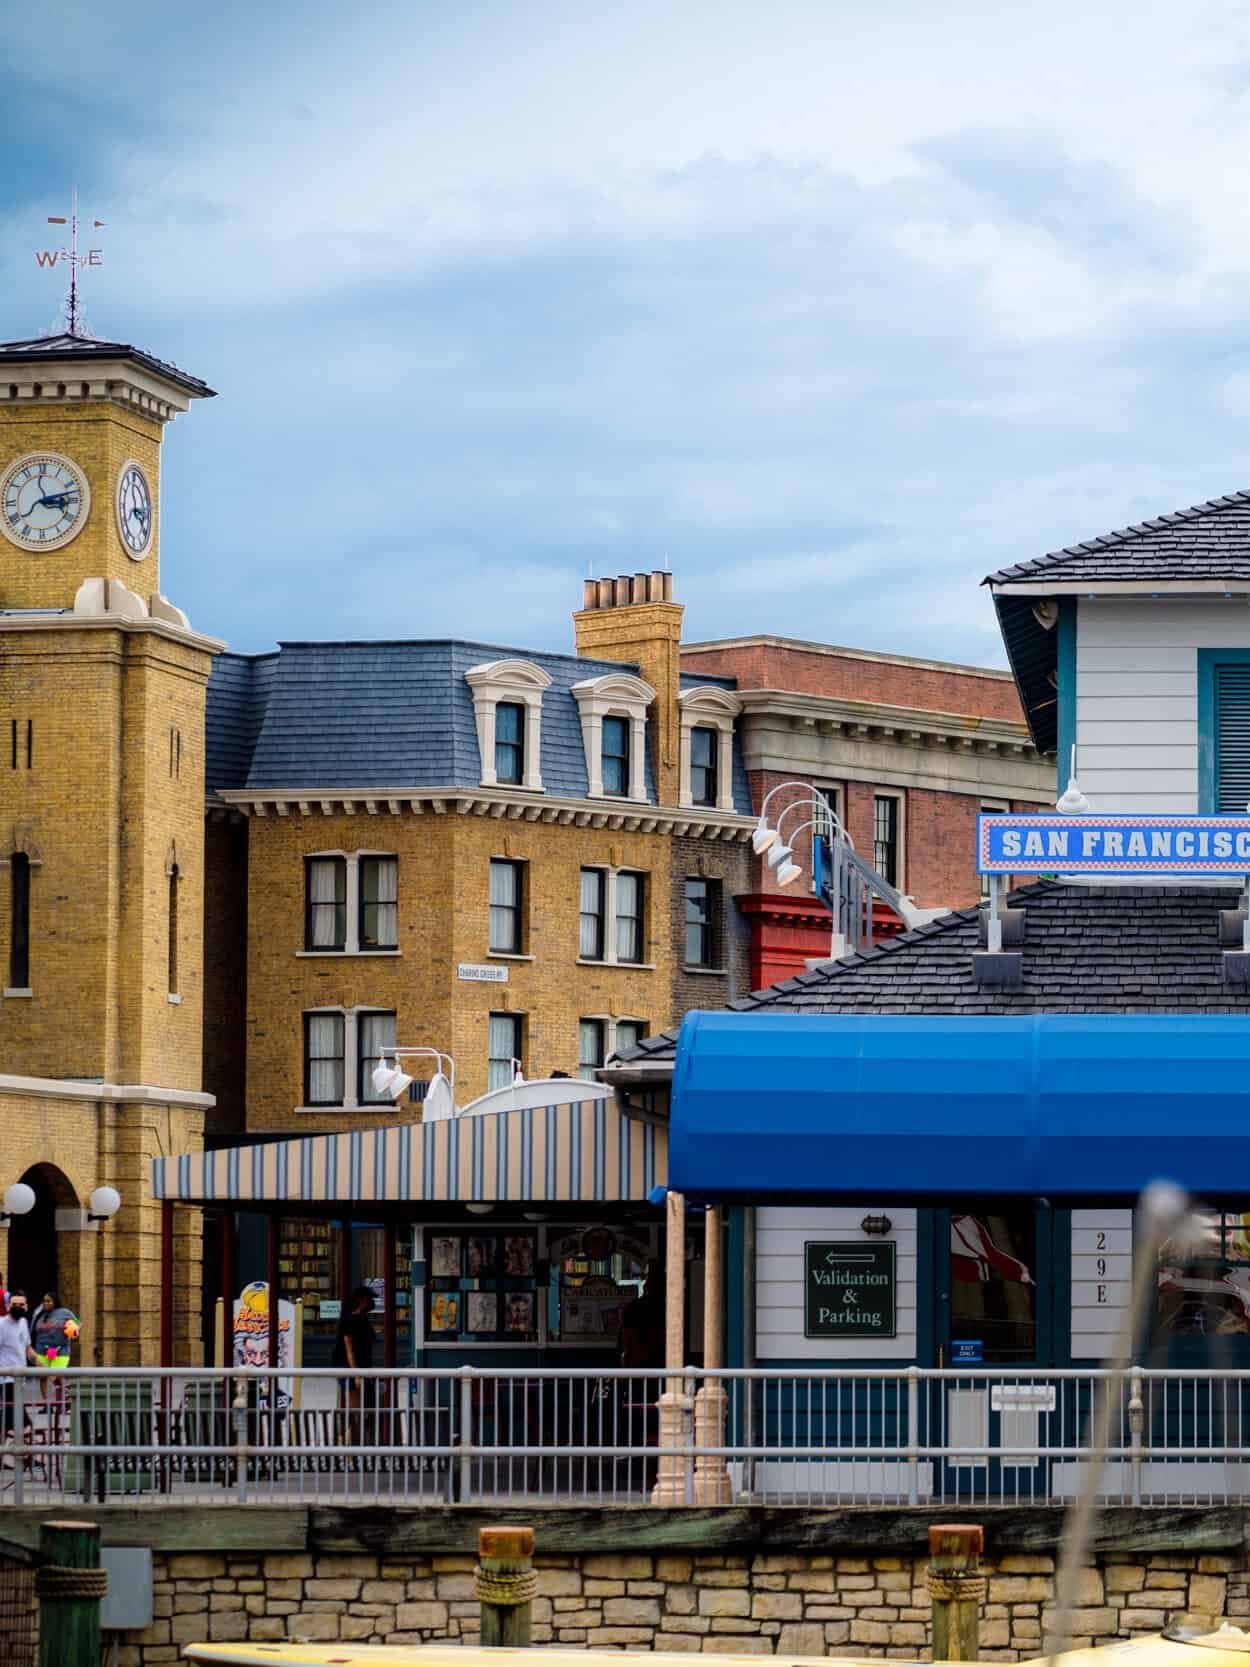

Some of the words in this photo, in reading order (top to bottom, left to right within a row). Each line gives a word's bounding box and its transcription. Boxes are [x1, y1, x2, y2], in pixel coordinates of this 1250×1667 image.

[36, 251, 58, 267] W
[89, 250, 102, 265] E
[1002, 830, 1069, 857] SAN
[812, 1269, 889, 1286] Validation
[842, 1288, 857, 1304] &
[819, 1306, 882, 1327] Parking
